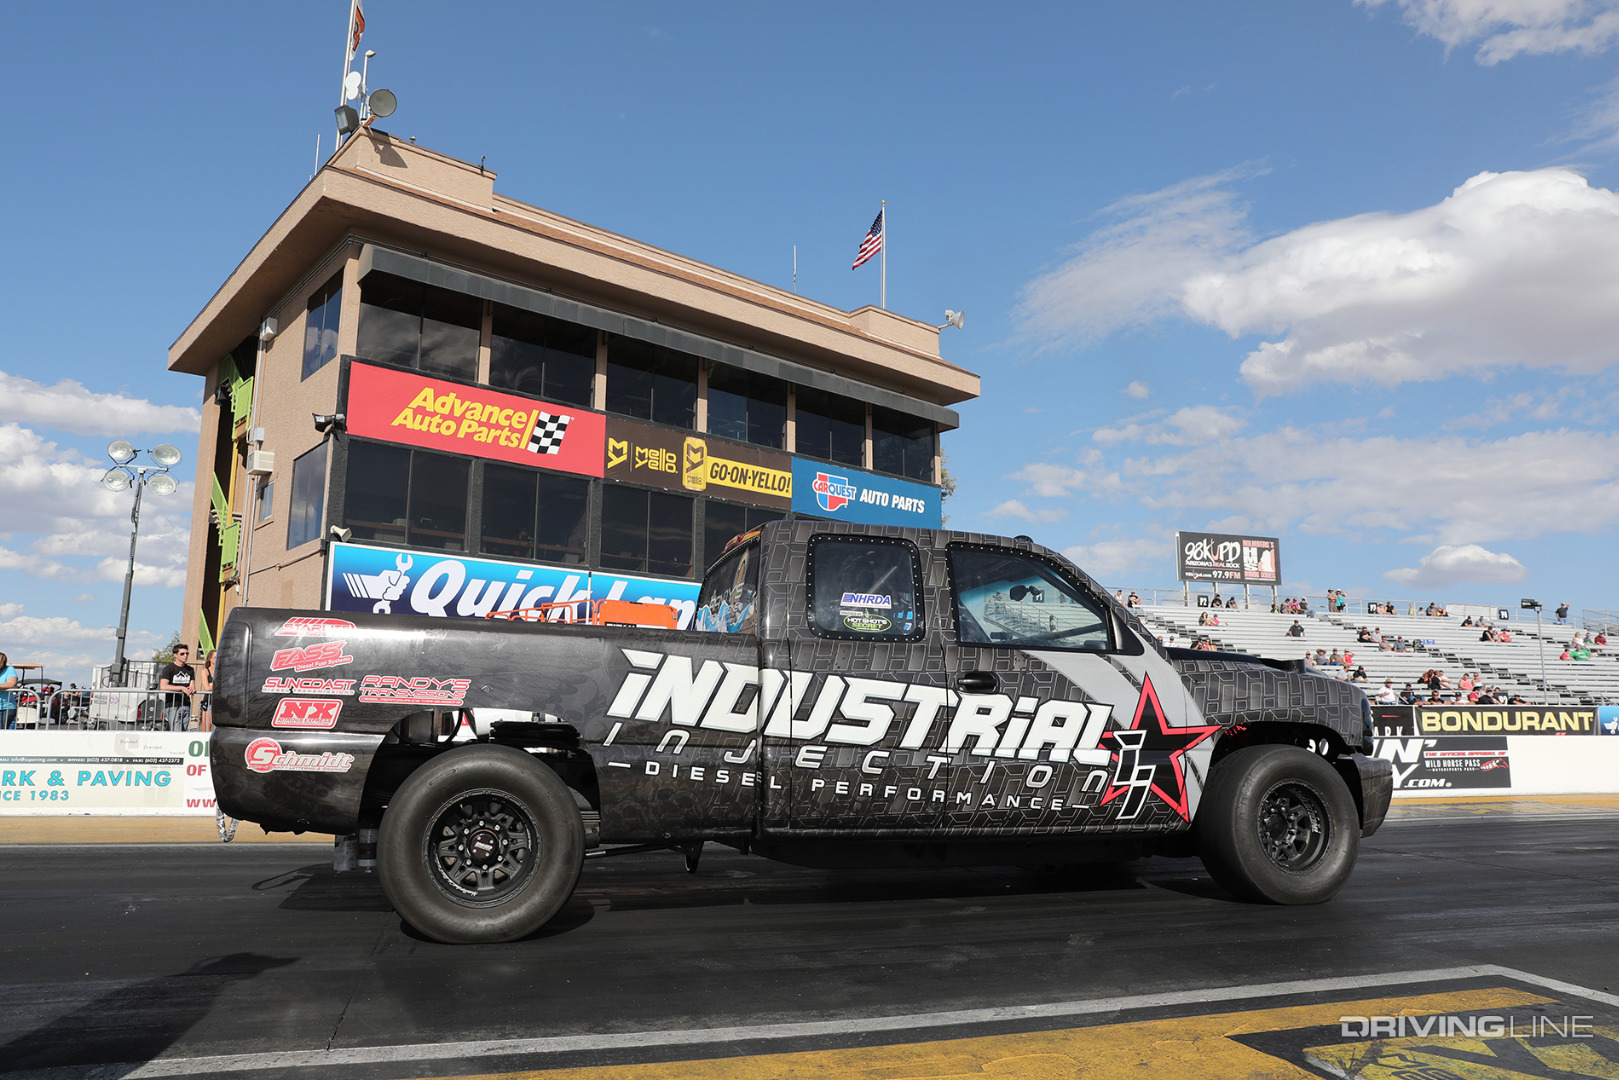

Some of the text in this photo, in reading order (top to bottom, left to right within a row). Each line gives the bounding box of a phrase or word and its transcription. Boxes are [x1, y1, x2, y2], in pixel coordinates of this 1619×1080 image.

[408, 387, 527, 429] Advance
[390, 407, 521, 448] Auto Parts
[813, 480, 856, 499] CARQUEST
[859, 488, 926, 514] AUTO PARTS
[410, 560, 592, 623] Quick
[850, 594, 890, 605] NHRDA
[273, 641, 346, 670] FASS
[328, 657, 351, 666] Systems
[264, 678, 356, 690] SUNCOAST
[362, 676, 471, 690] RANDY'S
[280, 702, 338, 719] NX
[1421, 711, 1594, 732] BONDURANT
[250, 747, 354, 768] Schmidt
[1425, 759, 1481, 768] WILD HORSE PASS
[47, 770, 65, 786] &
[77, 771, 172, 787] PAVING
[187, 764, 207, 776] OF
[645, 761, 1064, 811] DIESEL PERFORMANCE
[30, 790, 69, 801] 1983
